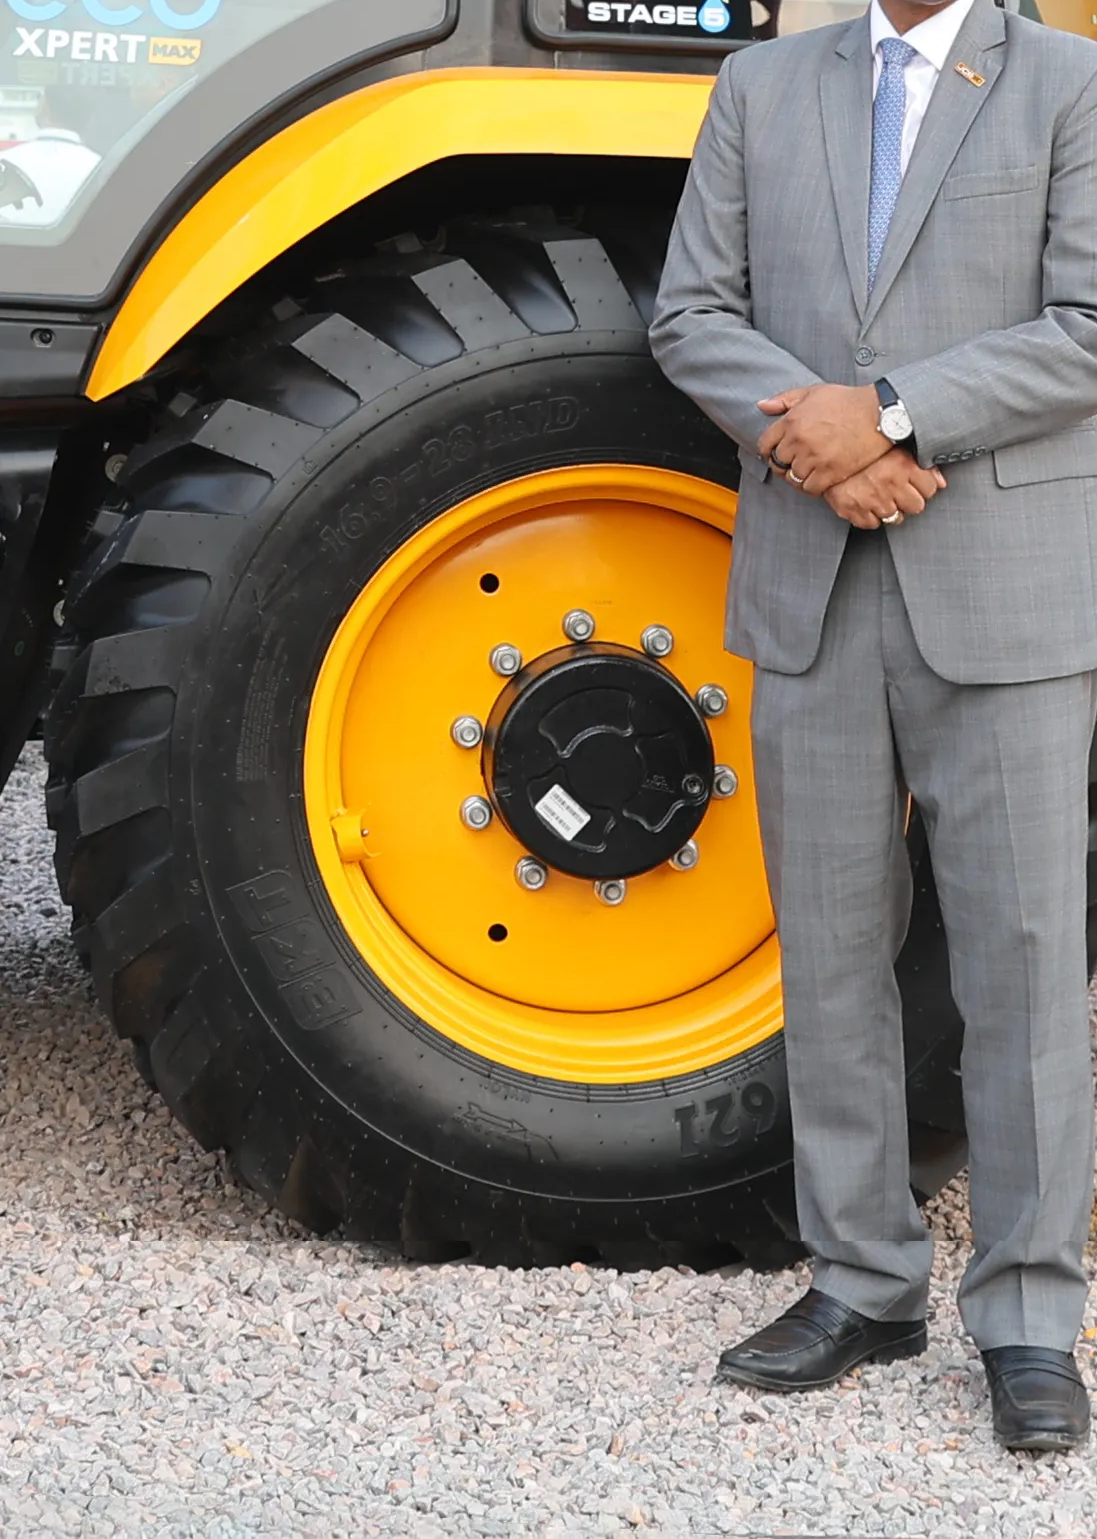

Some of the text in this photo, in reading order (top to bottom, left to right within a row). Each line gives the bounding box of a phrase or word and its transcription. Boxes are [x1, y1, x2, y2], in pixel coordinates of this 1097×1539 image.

[587, 1, 725, 27] STAGE 5
[13, 27, 199, 63] XPERT MAX
[674, 1081, 777, 1159] 621
